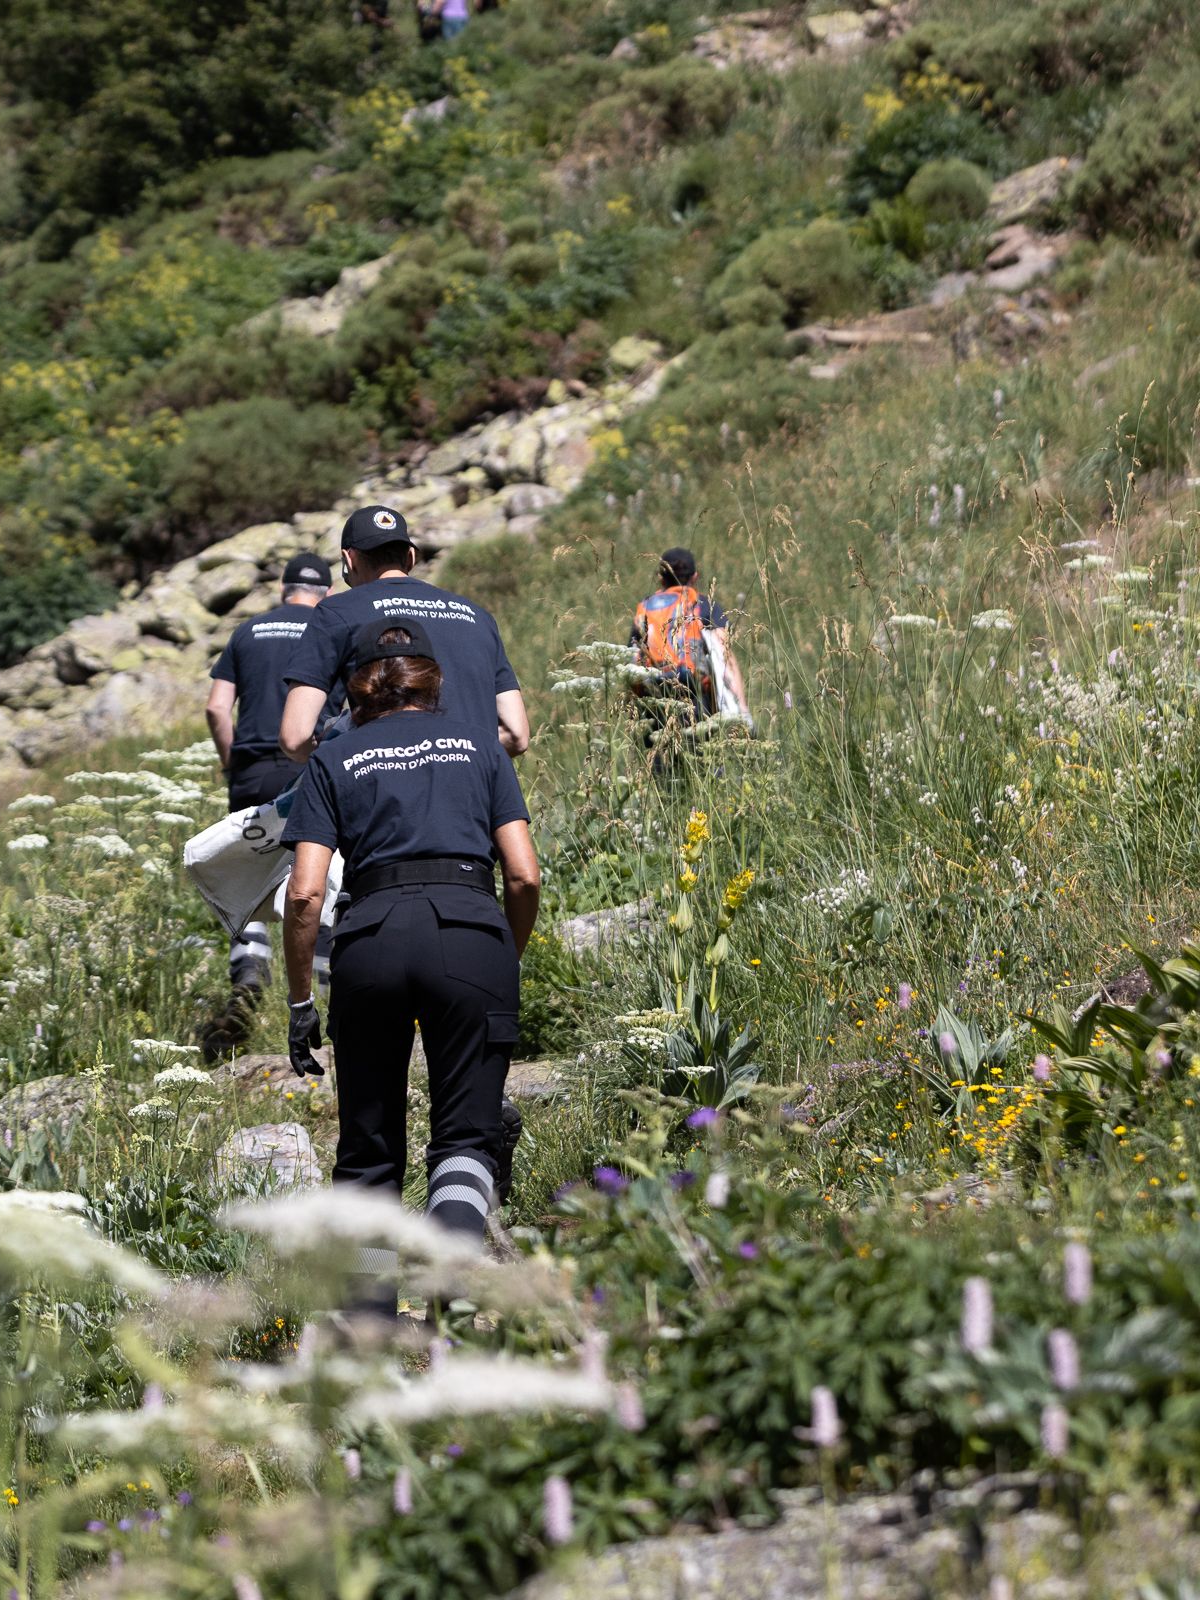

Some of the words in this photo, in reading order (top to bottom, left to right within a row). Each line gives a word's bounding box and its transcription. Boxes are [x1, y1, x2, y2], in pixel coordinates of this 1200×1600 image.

[373, 597, 446, 609] PROTECCIÓ
[448, 600, 475, 615] CIVIL
[384, 608, 428, 617] PRINCIPAT
[430, 611, 476, 624] D'ANDORRA
[343, 739, 432, 771] PROTECCIÓ
[435, 738, 476, 751] CIVIL
[353, 762, 407, 779] PRINCIPAT
[408, 753, 471, 770] D'ANDORRA
